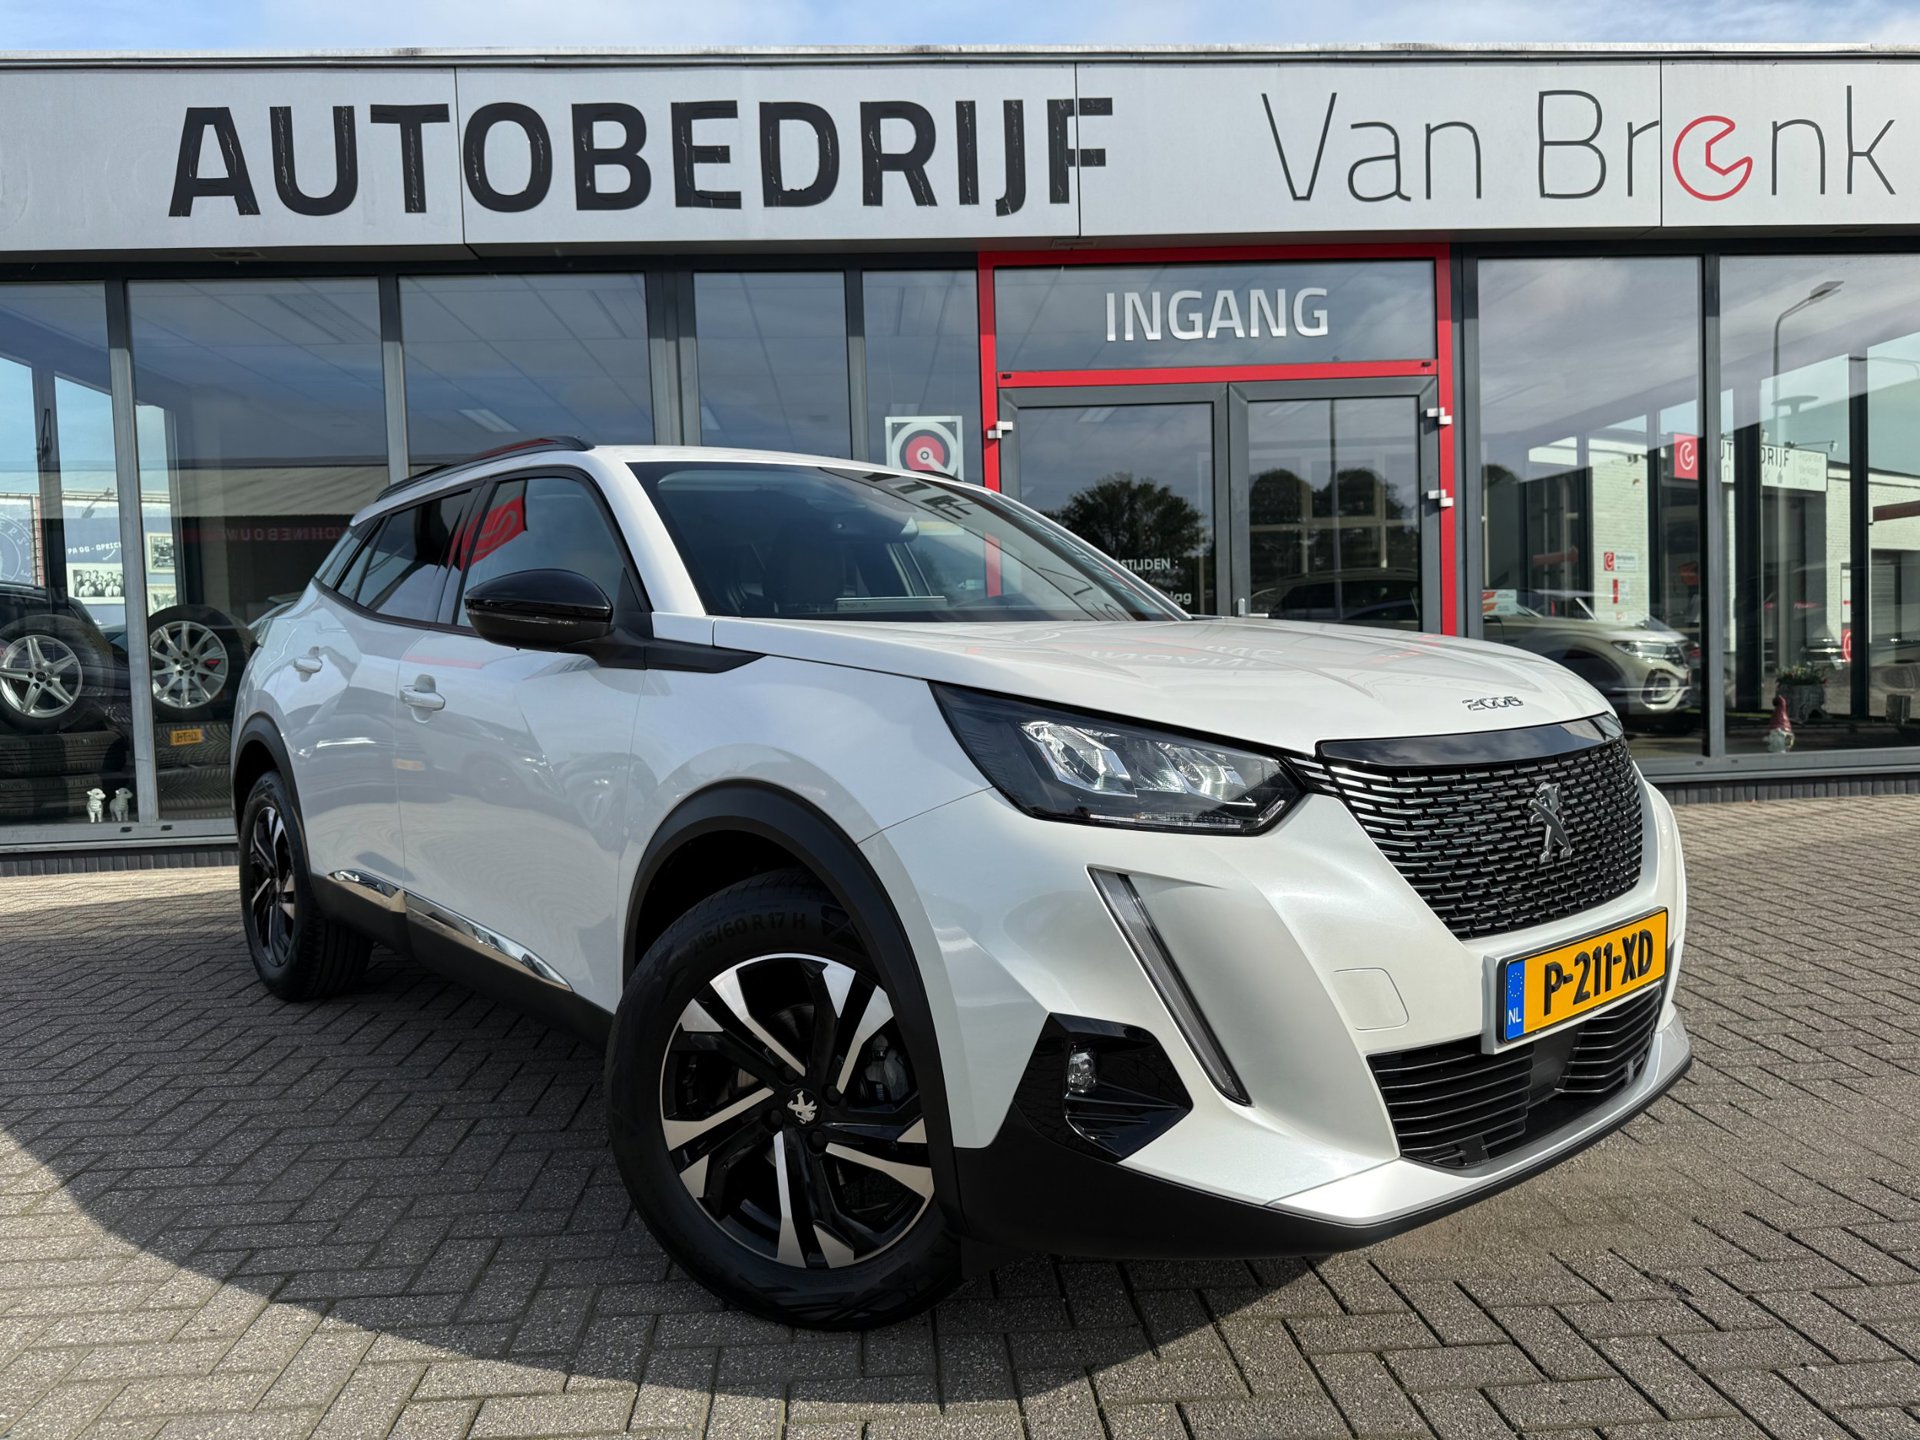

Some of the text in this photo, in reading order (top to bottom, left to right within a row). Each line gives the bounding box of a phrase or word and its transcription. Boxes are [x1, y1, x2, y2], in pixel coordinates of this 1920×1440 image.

[169, 98, 1113, 217] AUTOBEDRIJF
[1262, 92, 1482, 202] Van
[1105, 287, 1329, 342] INGANG
[1543, 929, 1654, 1017] P-211-XD
[1508, 1007, 1522, 1026] NL
